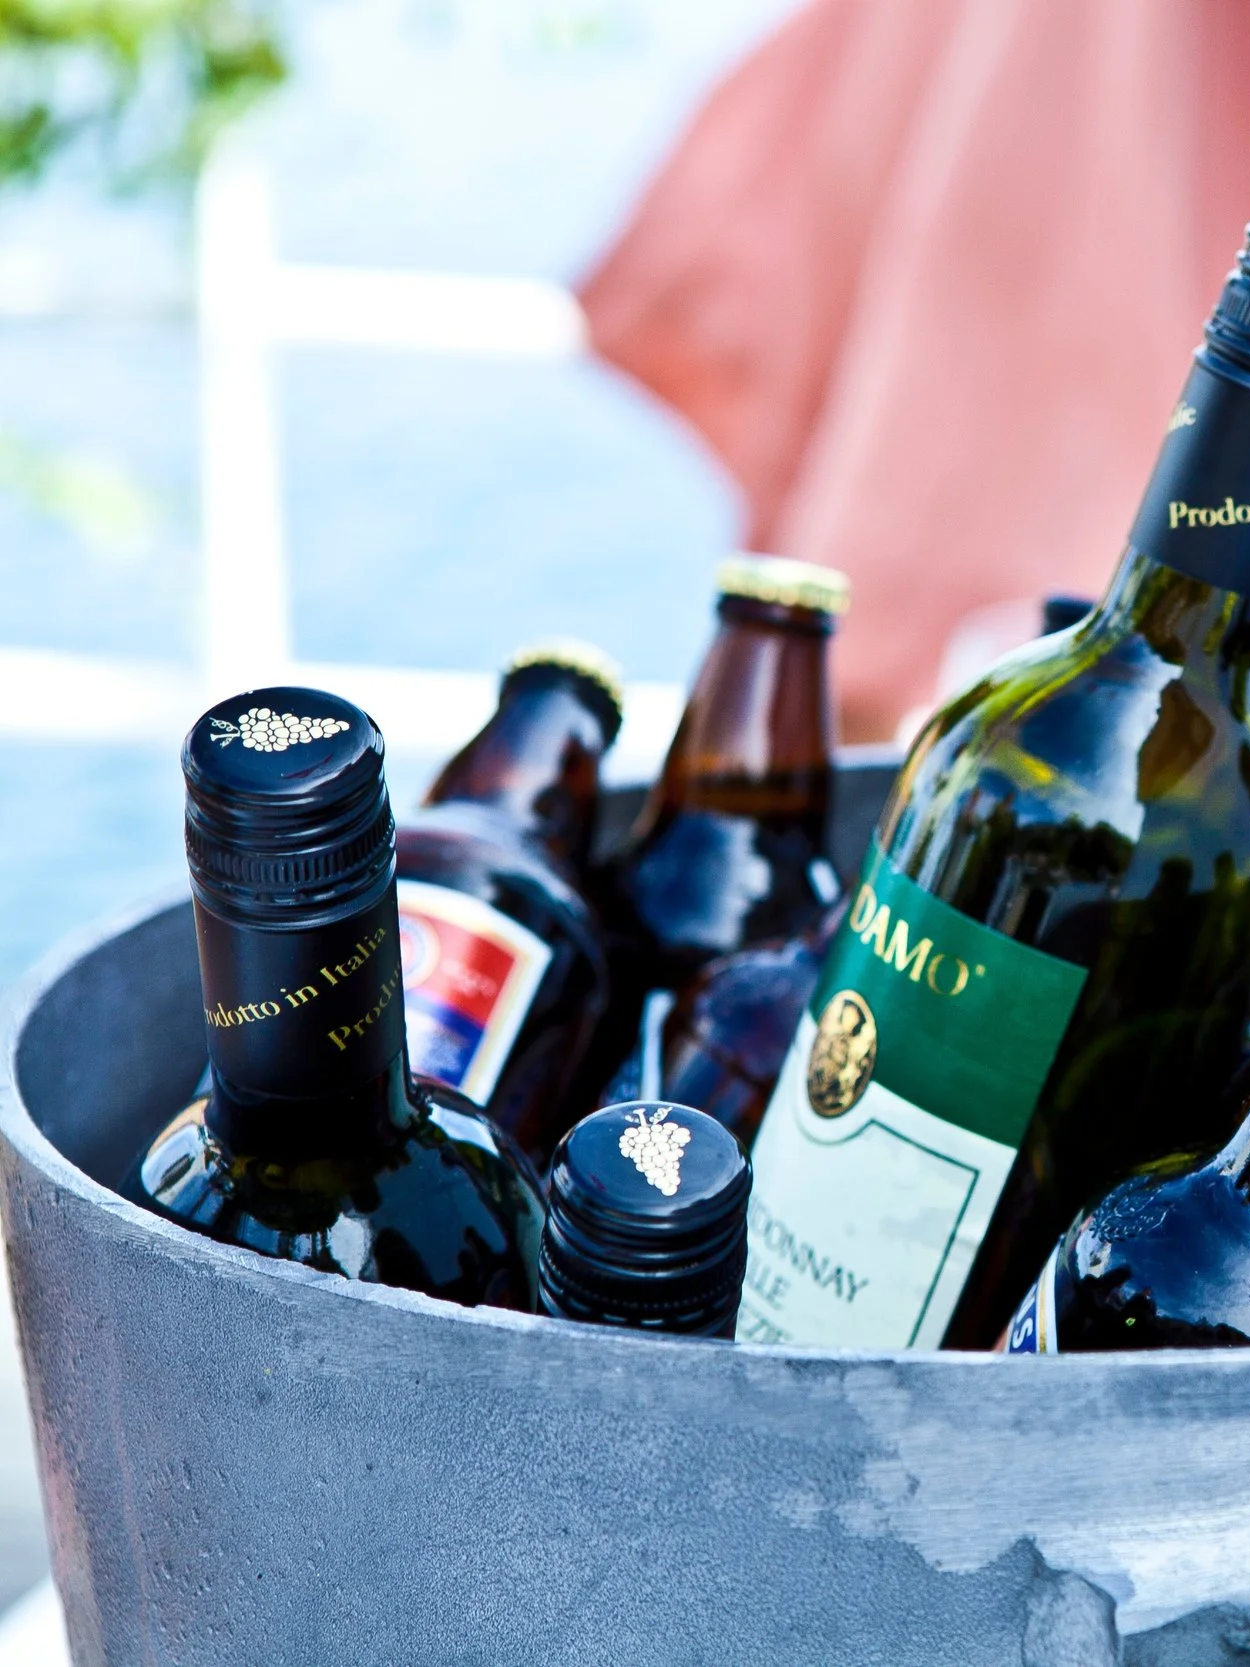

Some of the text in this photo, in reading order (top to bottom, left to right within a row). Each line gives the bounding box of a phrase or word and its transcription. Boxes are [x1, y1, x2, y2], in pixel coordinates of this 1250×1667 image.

[204, 926, 387, 1029] rodotto in Italia
[327, 962, 401, 1052] Produ
[749, 1194, 870, 1305] DONNAY
